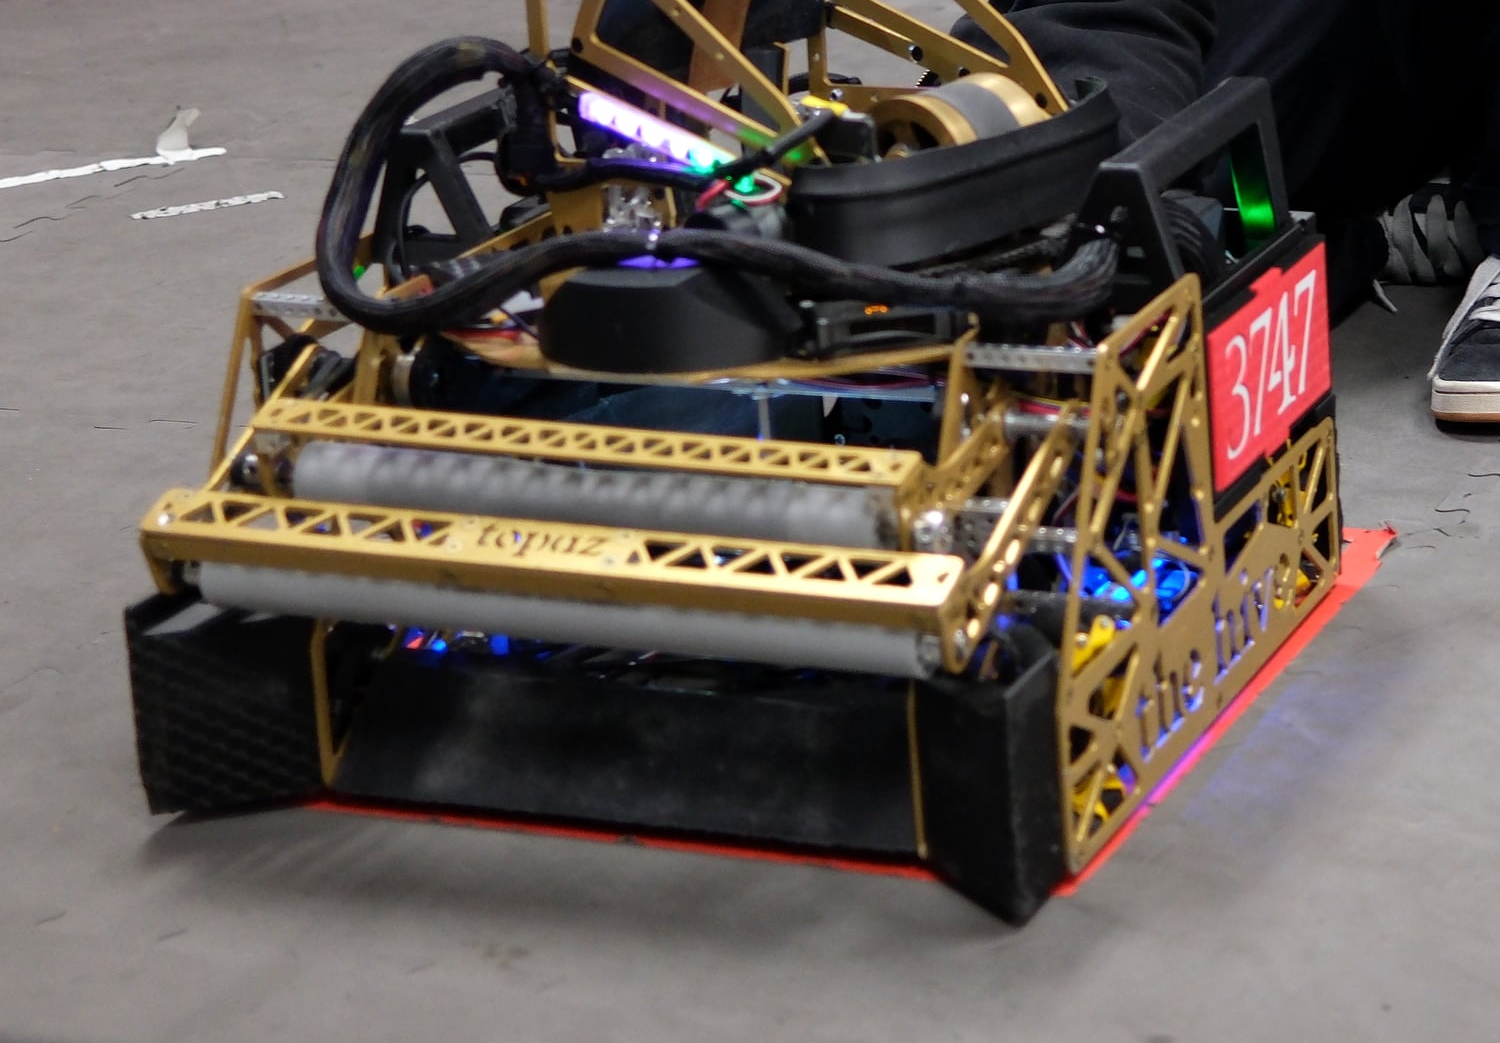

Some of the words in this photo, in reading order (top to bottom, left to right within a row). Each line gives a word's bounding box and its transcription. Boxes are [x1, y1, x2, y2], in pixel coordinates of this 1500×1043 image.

[1225, 269, 1317, 460] 3747
[477, 522, 612, 557] topaz
[1135, 649, 1205, 763] the
